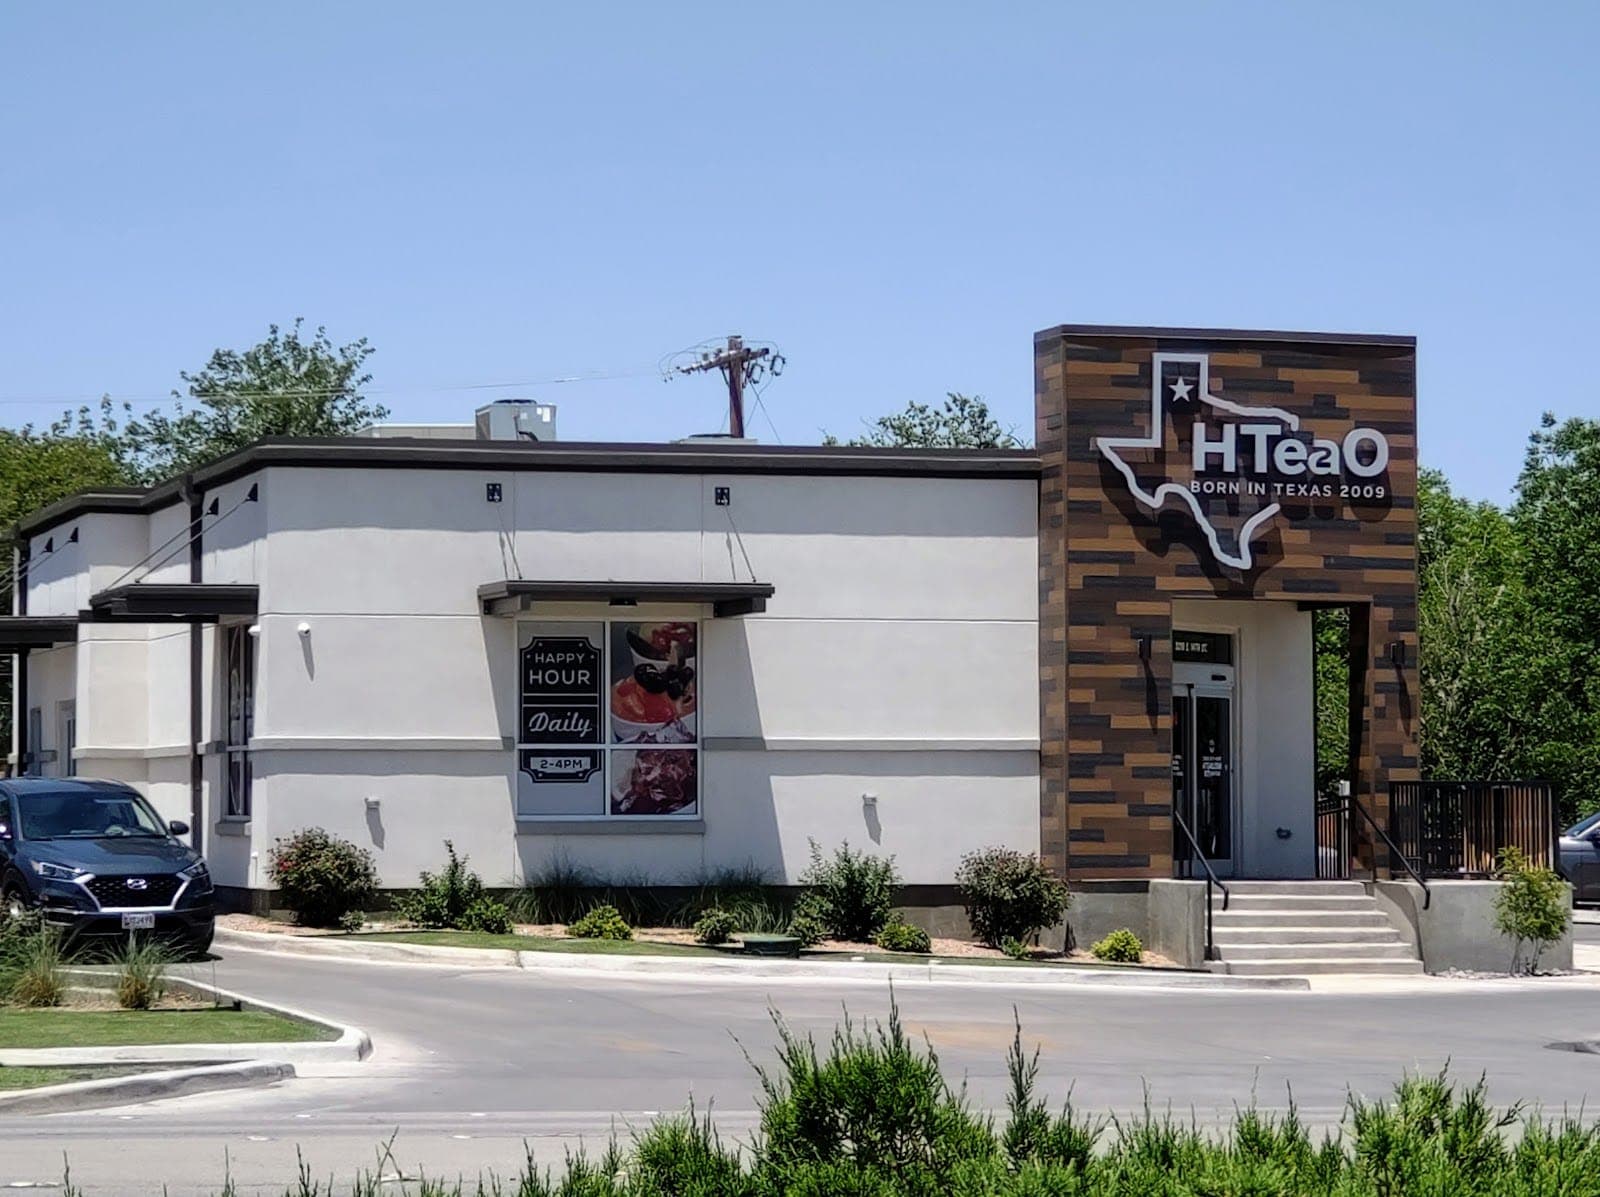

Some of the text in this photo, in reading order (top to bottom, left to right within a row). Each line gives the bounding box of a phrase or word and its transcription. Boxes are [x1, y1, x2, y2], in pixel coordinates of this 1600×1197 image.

[1192, 422, 1389, 478] HTeaO
[1190, 480, 1385, 499] BORN IN TEXAS 2009
[534, 652, 585, 664] HAPPY
[529, 669, 591, 685] HOUR
[528, 711, 592, 738] Daily
[540, 758, 583, 769] 2-4PM
